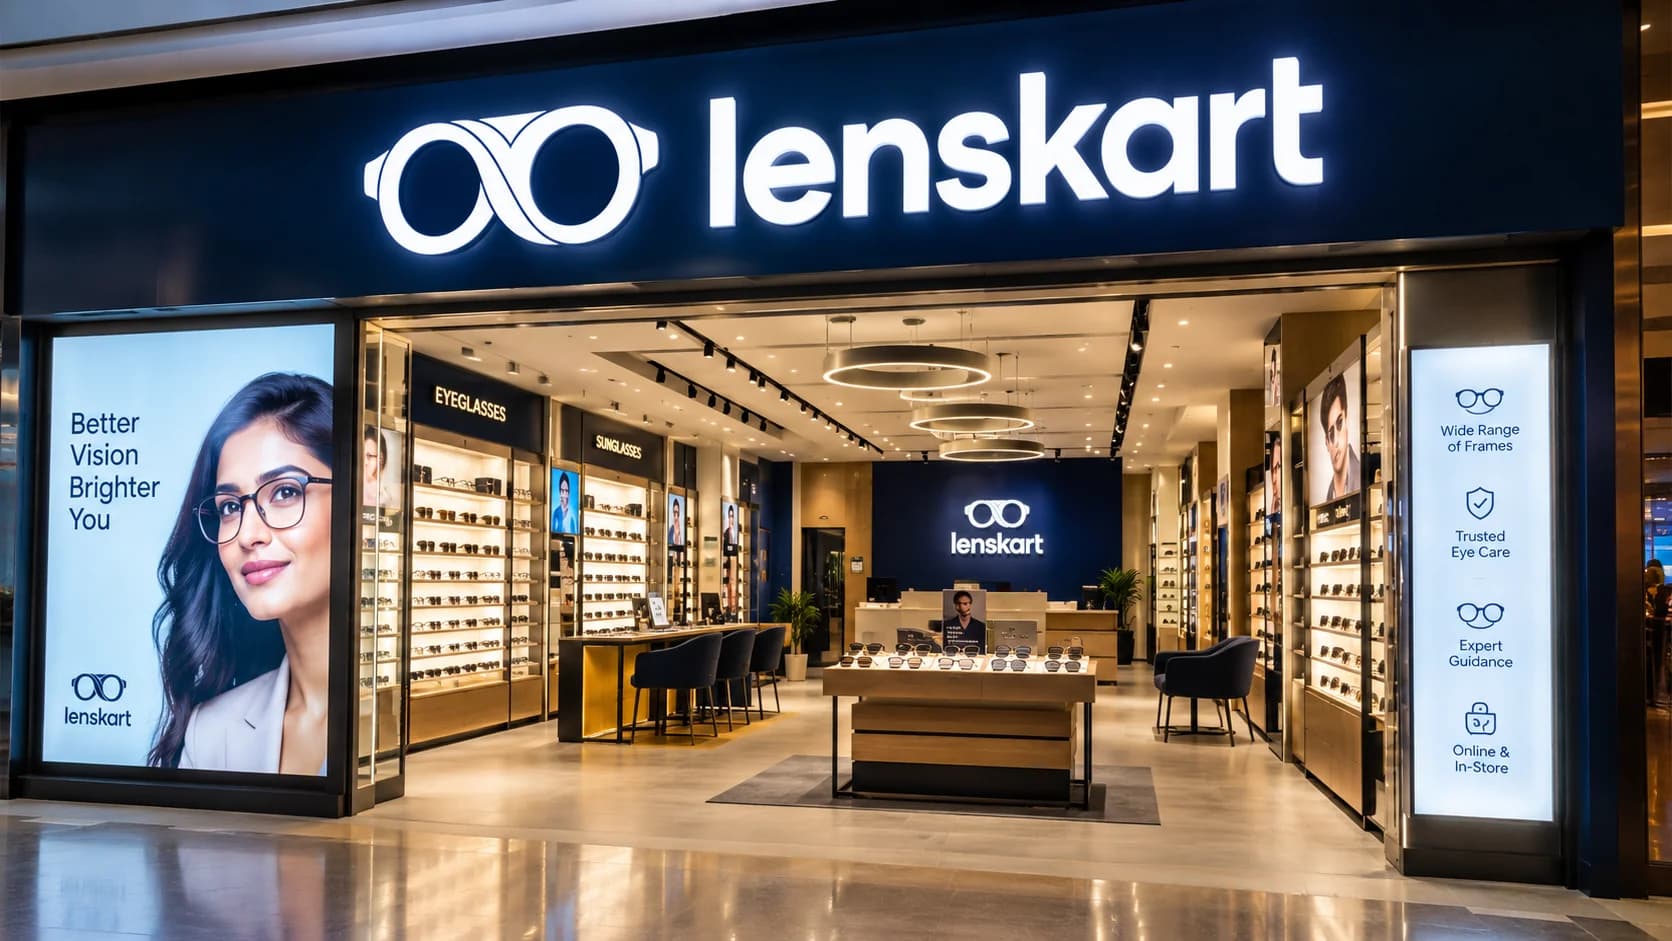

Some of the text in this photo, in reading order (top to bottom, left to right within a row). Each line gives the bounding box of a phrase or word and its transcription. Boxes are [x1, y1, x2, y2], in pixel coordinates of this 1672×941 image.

[709, 56, 1324, 229] lenskart
[435, 386, 506, 422] EYEGLASSES
[71, 412, 140, 435] Better
[1440, 424, 1520, 438] Wide Range
[70, 442, 138, 467] Vision
[595, 434, 642, 460] SUNGLASSES
[1447, 440, 1513, 453] of Frames
[70, 474, 161, 505] Brighter
[69, 507, 110, 531] You
[951, 531, 1044, 555] lenskart
[1455, 530, 1506, 543] Trusted
[1451, 545, 1511, 561] Eye Care
[1459, 639, 1503, 654] Expert
[1448, 655, 1513, 668] Guidance
[64, 706, 132, 727] lenskart
[1452, 744, 1510, 758] Online &
[1454, 760, 1509, 774] In-Store
